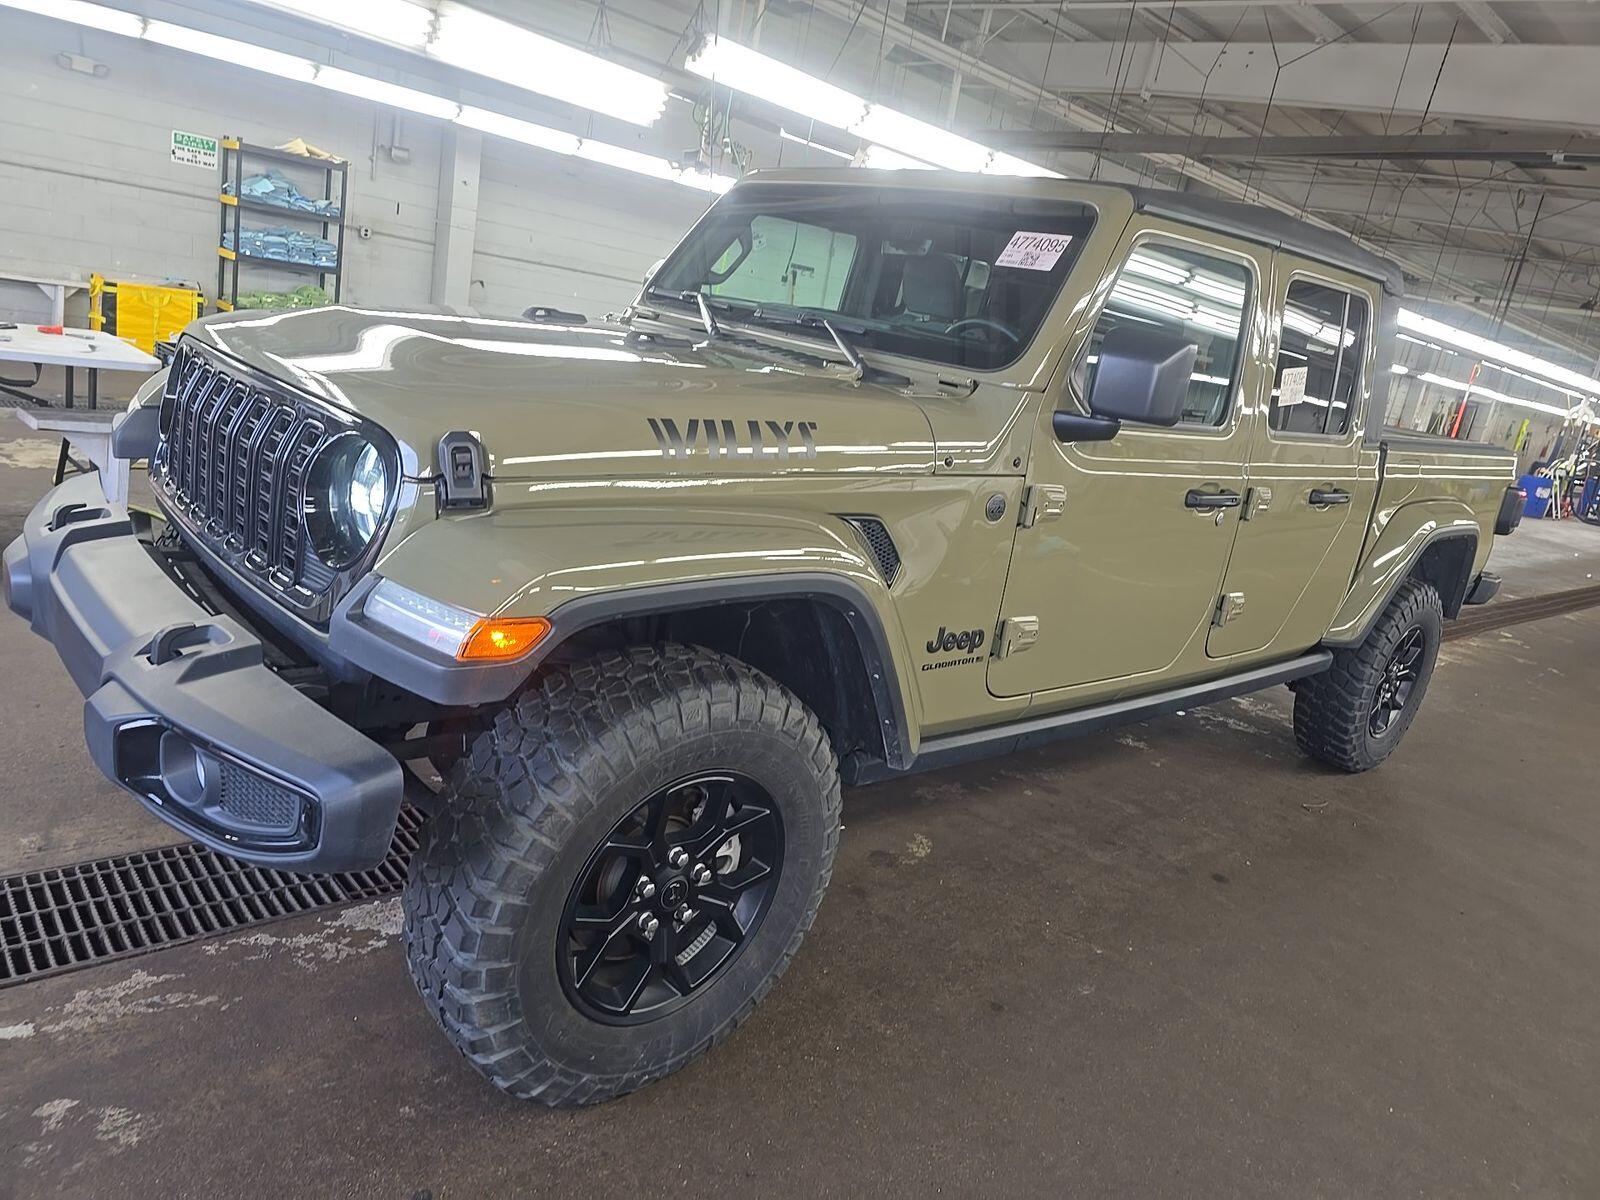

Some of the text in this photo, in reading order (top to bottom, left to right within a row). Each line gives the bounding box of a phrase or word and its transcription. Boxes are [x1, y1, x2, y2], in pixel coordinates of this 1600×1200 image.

[1009, 235, 1069, 253] 4774095
[647, 418, 818, 460] WILLYS
[926, 626, 985, 654] Jeep
[921, 656, 975, 672] GLADIATOR
